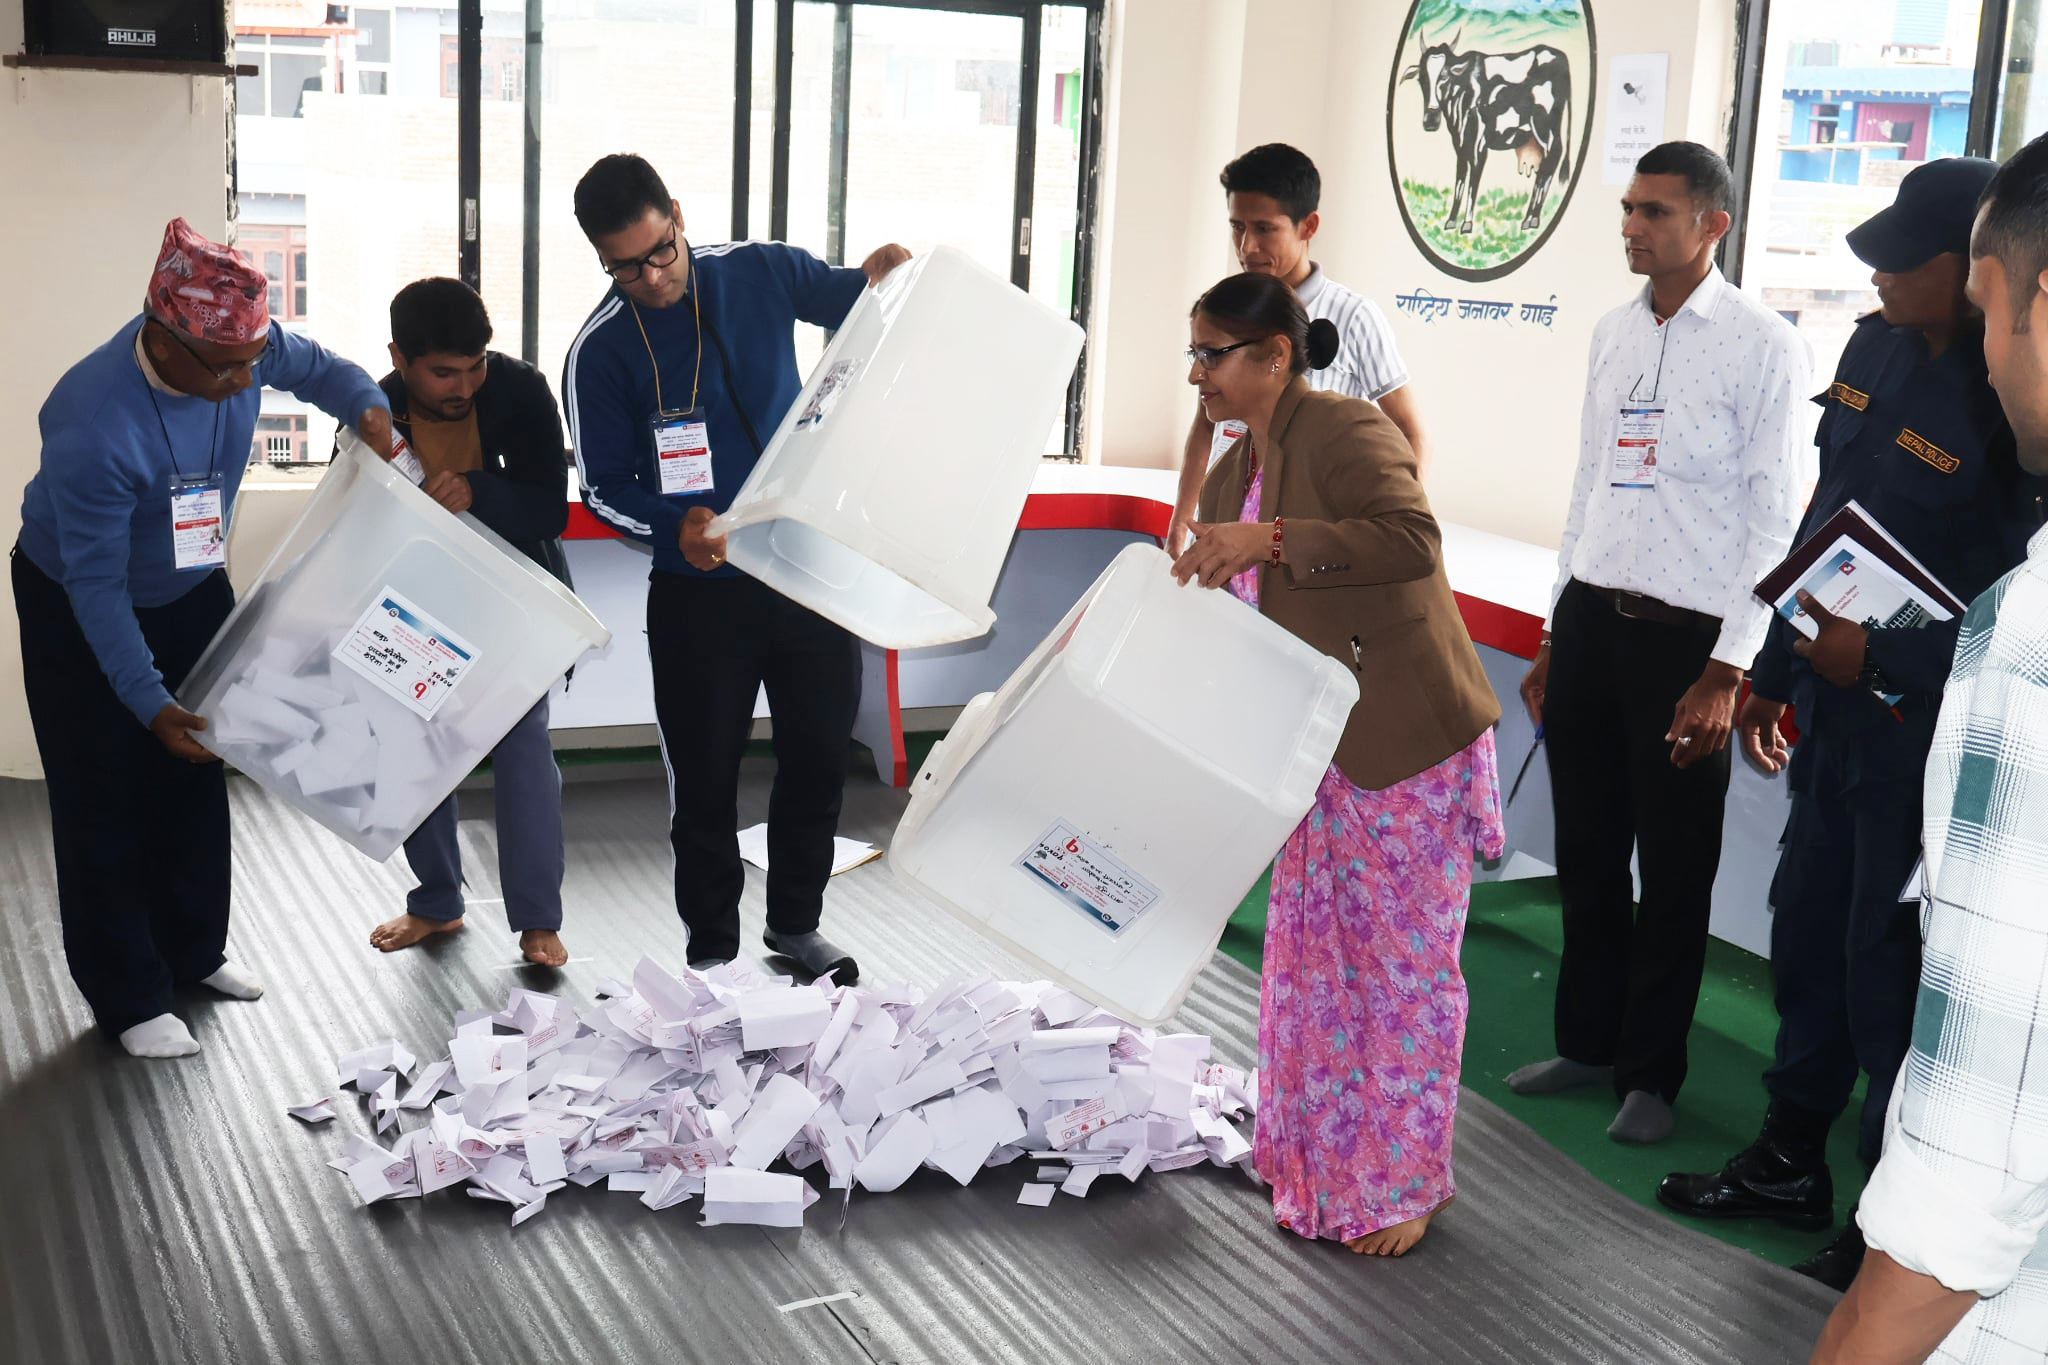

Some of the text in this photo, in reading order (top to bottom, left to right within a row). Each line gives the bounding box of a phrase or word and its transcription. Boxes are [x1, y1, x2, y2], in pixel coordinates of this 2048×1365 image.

[108, 31, 156, 44] AHUJA
[1396, 288, 1452, 325] राष्ट्रिय
[1457, 299, 1513, 327] जनावर
[1902, 433, 1953, 470] NEPAL POLICE
